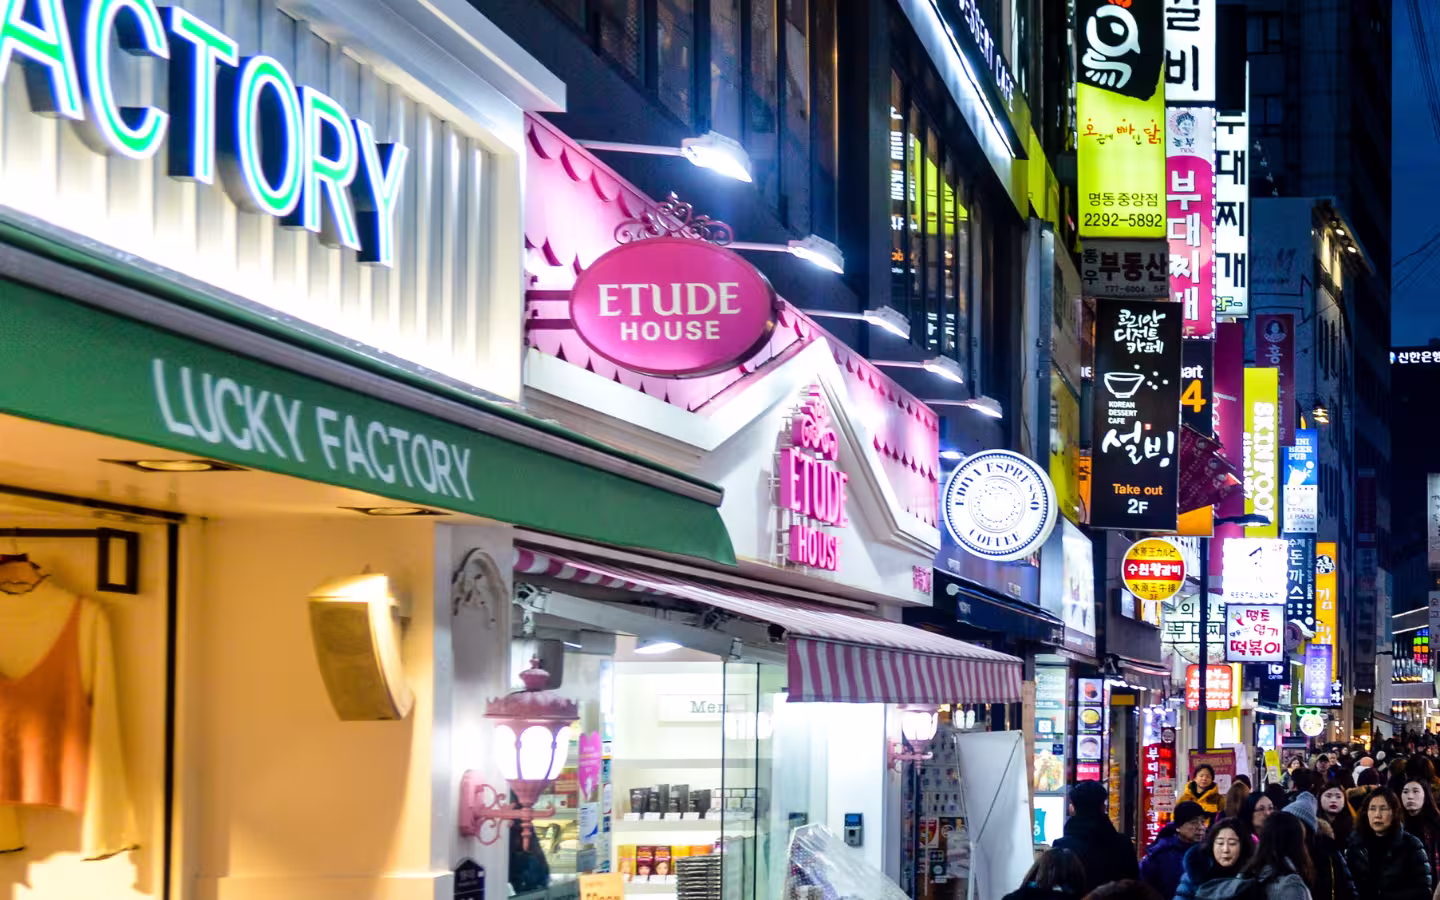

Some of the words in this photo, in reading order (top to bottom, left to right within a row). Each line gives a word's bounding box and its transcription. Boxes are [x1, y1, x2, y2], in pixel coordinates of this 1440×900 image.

[958, 0, 994, 70] ESSERT
[995, 54, 1014, 112] CAFE
[1088, 192, 1158, 207] 명동중앙점
[1084, 213, 1162, 228] 2292-5892
[1100, 251, 1168, 282] 부동산
[597, 281, 741, 317] ETUDE
[620, 320, 720, 341] HOUSE
[1108, 401, 1135, 409] KOREAN
[153, 358, 306, 463] LUCKY
[315, 406, 475, 500] FACTORY
[1108, 417, 1125, 425] CAFE
[789, 446, 848, 528] ETUDE
[1113, 484, 1140, 495] Take
[1144, 485, 1163, 495] out
[1127, 499, 1148, 514] 2F
[797, 525, 843, 572] HOUSE
[1128, 563, 1181, 576] 수원왕갈비
[1289, 550, 1305, 600] 돈까스
[1231, 639, 1280, 657] 떡볶이
